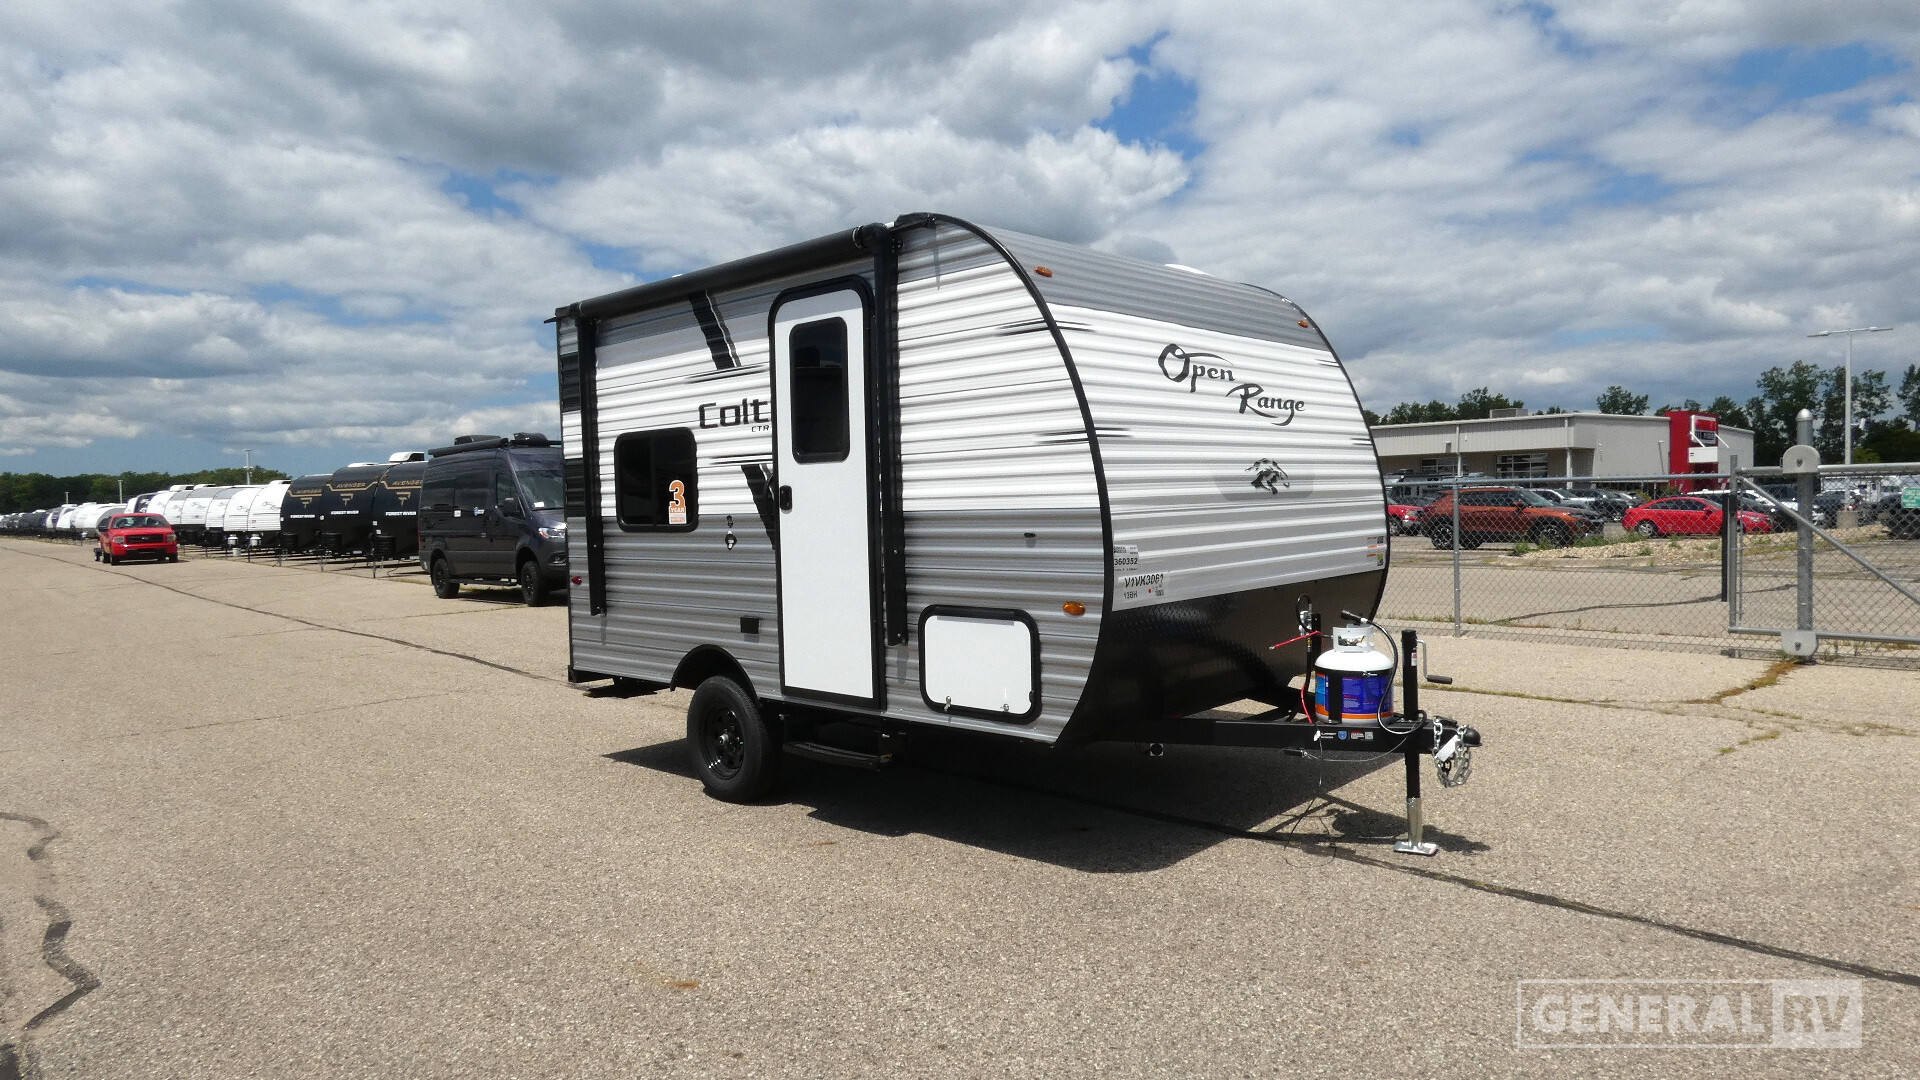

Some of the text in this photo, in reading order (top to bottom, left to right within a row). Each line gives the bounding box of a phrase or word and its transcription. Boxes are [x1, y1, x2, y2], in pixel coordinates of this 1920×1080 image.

[1158, 343, 1236, 393] Open
[698, 398, 770, 429] Colt
[1225, 383, 1306, 427] Range
[669, 479, 686, 507] 3
